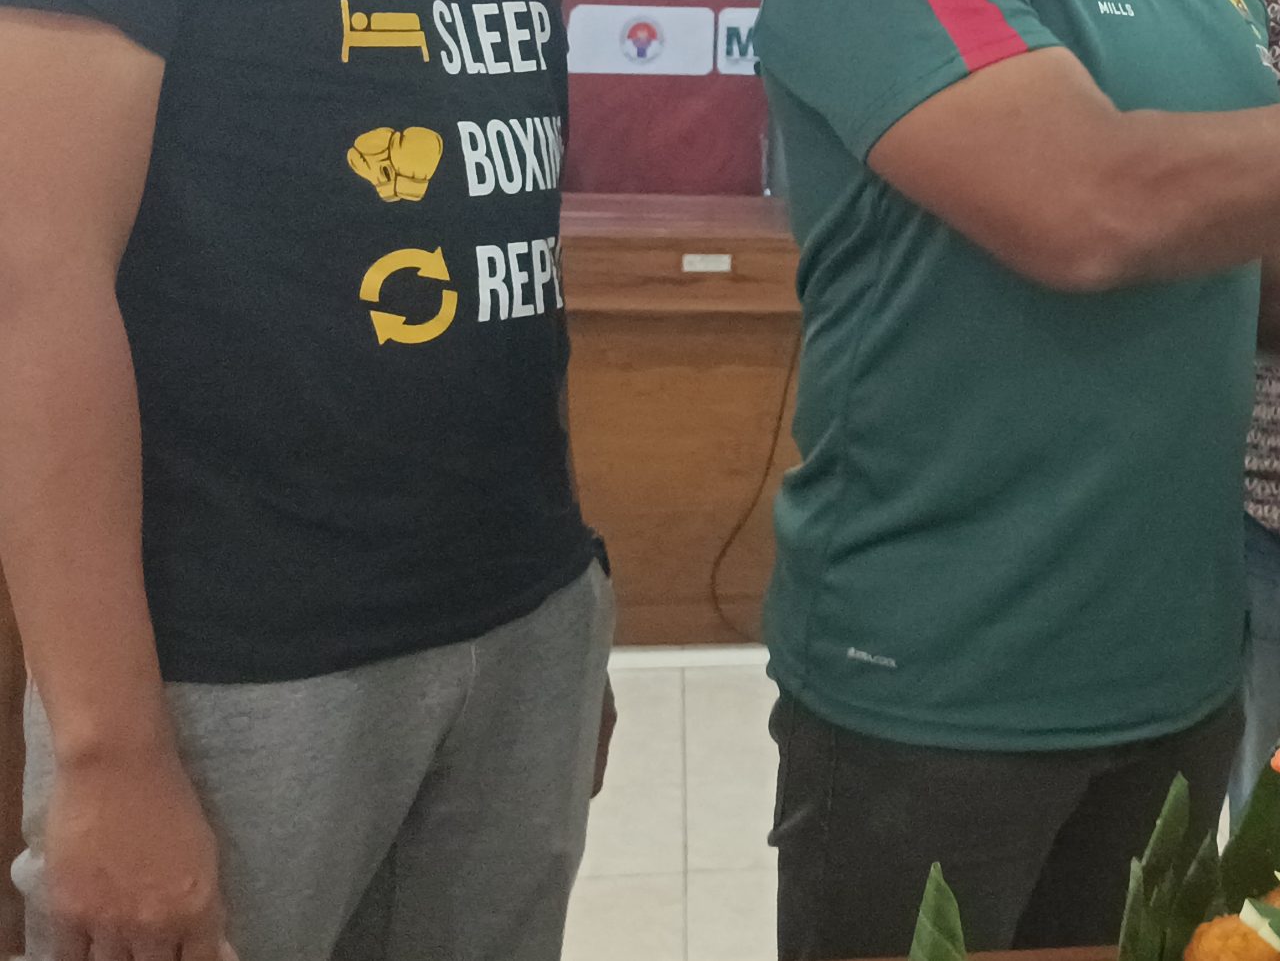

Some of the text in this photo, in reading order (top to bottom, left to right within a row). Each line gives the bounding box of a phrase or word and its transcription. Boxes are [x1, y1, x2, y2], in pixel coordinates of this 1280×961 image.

[432, 0, 551, 75] SLEEP
[1097, 0, 1135, 17] MILLS
[457, 115, 564, 197] BOXIN
